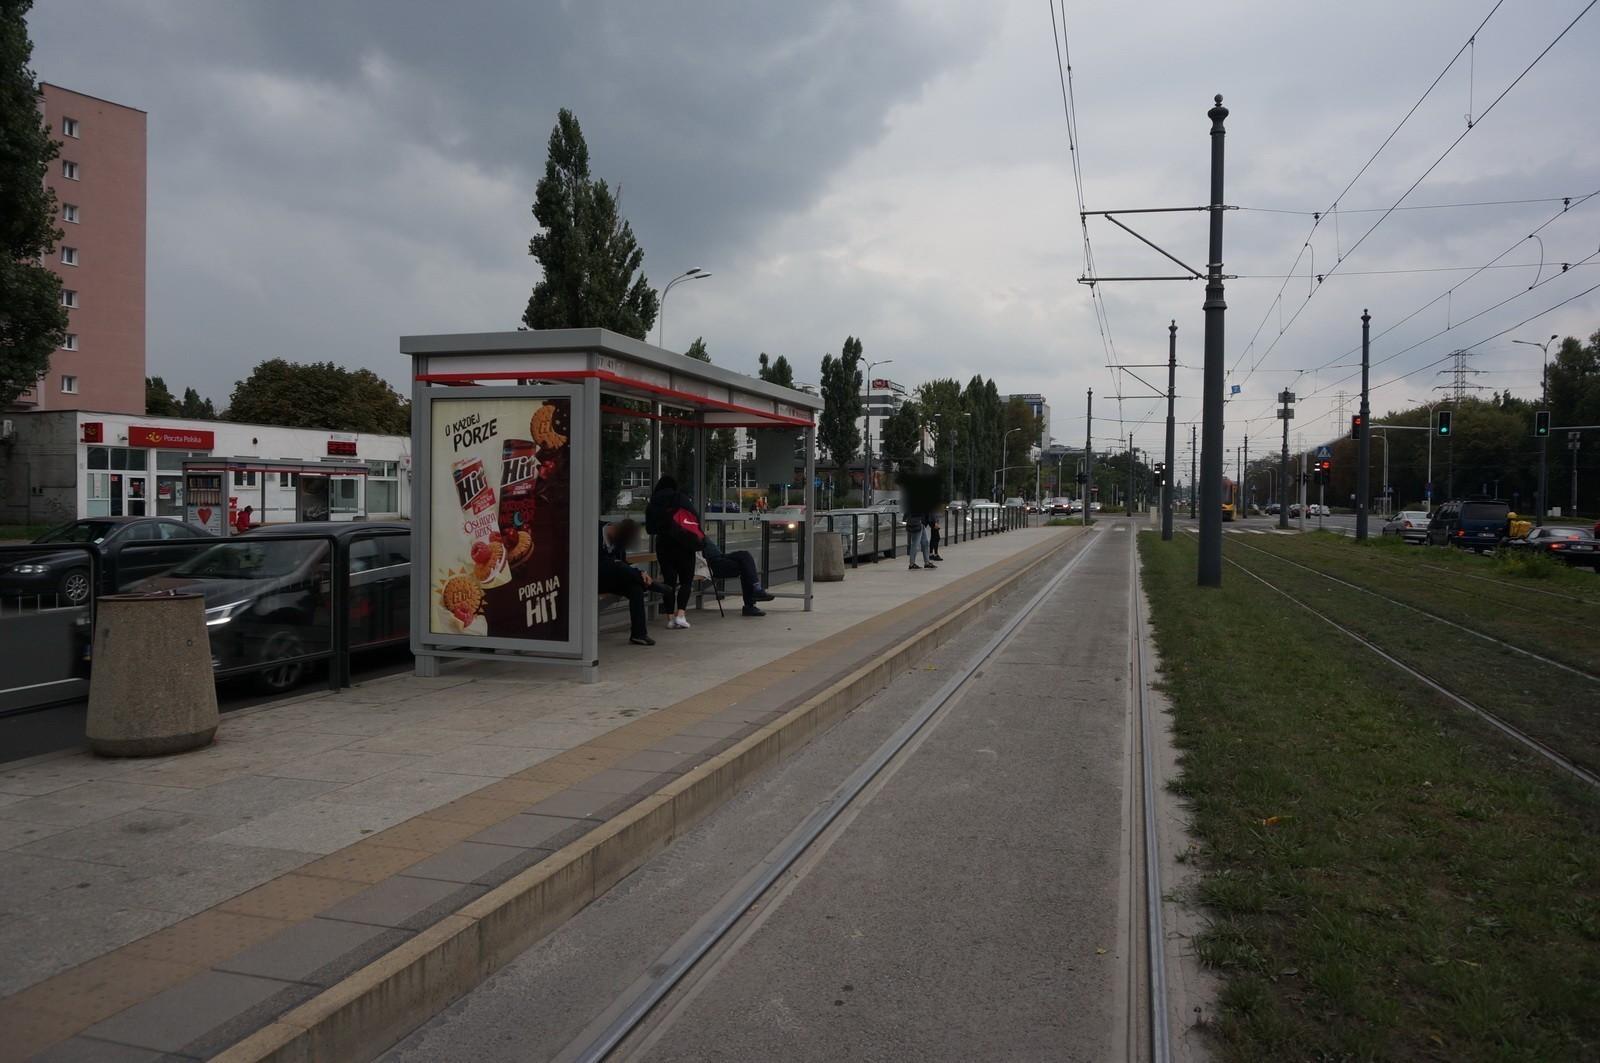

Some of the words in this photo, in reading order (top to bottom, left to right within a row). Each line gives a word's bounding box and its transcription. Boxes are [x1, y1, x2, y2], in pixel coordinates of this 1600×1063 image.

[163, 434, 183, 442] Poczta
[183, 435, 202, 443] Polska
[445, 425, 451, 437] O
[452, 413, 480, 434] KAŻDEJ
[453, 418, 498, 452] PORZE
[501, 455, 536, 487] Hit
[456, 469, 487, 508] Hit
[518, 580, 544, 602] PORA
[545, 575, 560, 592] NA
[525, 591, 559, 628] HIT
